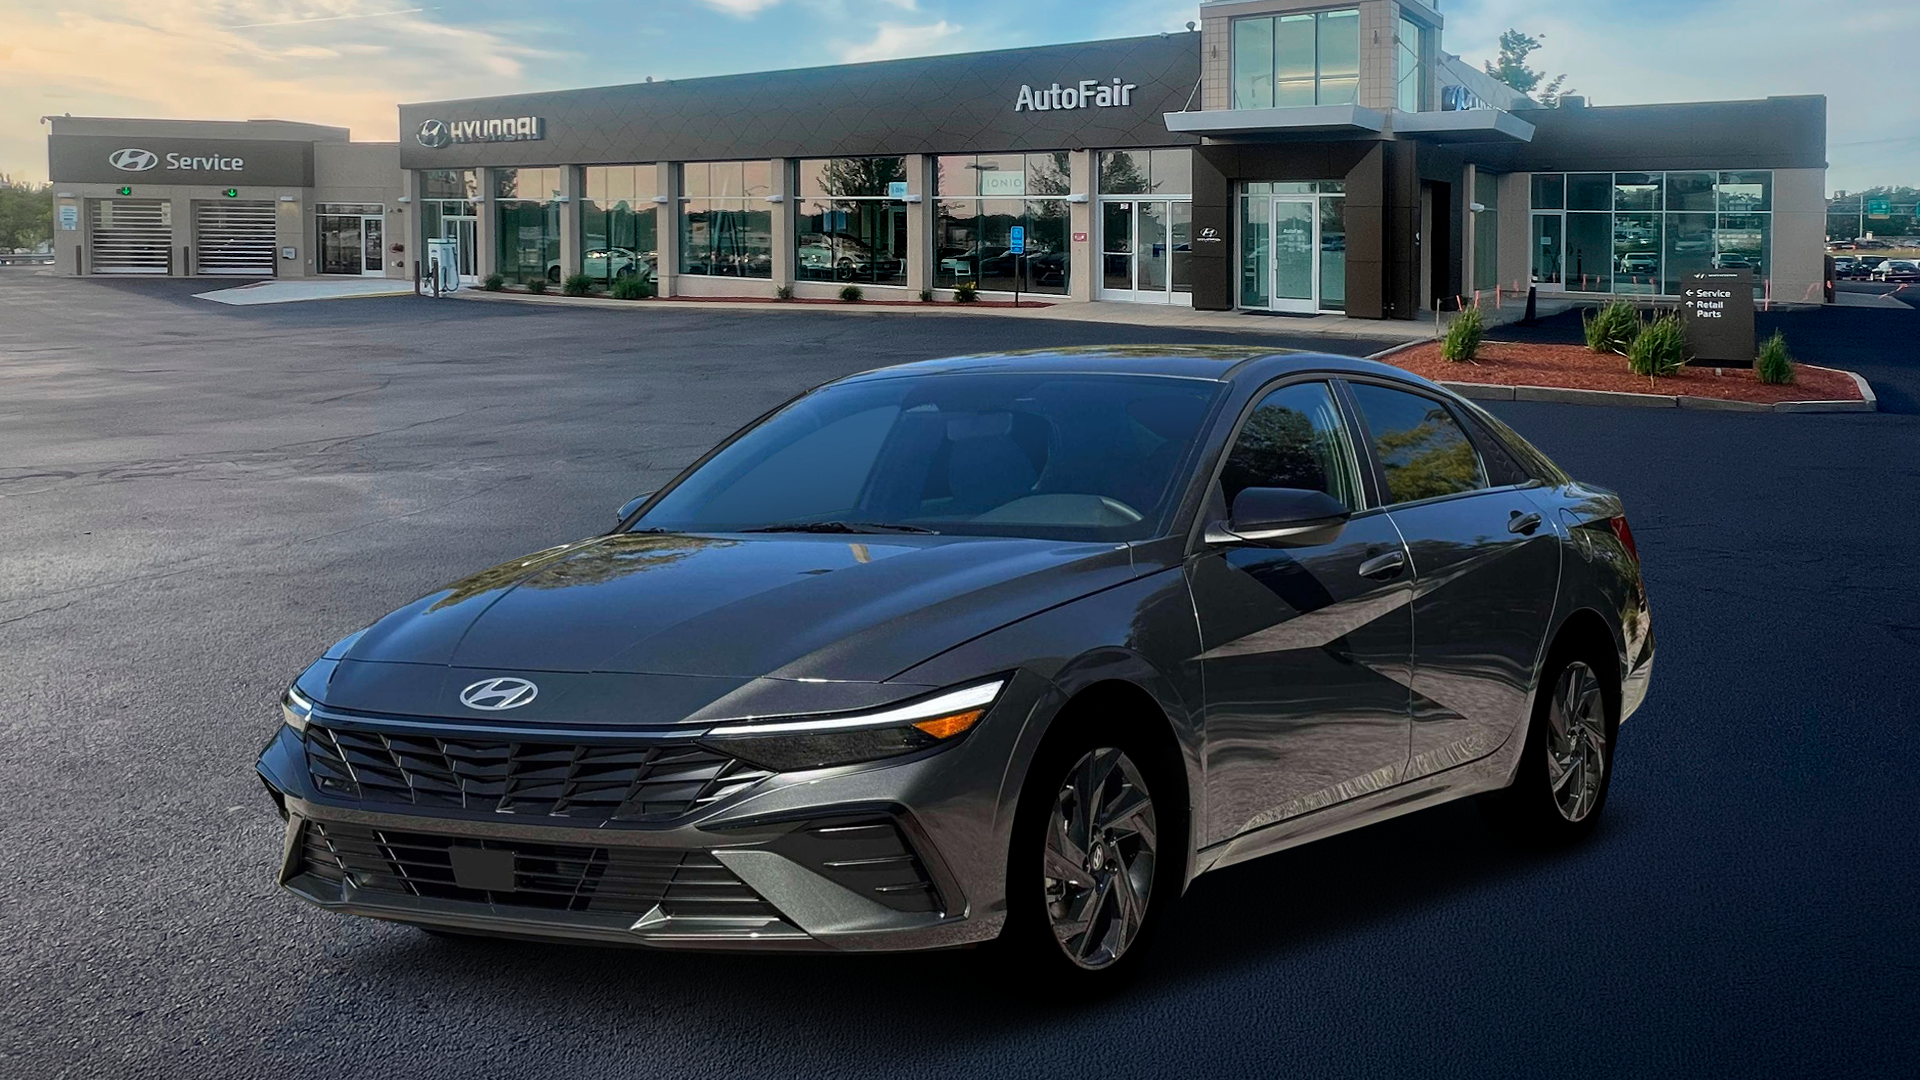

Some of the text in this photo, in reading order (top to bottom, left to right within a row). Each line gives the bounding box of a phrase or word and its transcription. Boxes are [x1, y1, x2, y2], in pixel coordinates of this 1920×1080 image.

[1015, 77, 1137, 112] AutoFair
[450, 116, 543, 143] HYUNDAI
[166, 152, 244, 171] Service
[1696, 289, 1731, 298] Service
[1696, 300, 1724, 309] Retail
[1696, 310, 1722, 318] Parts
